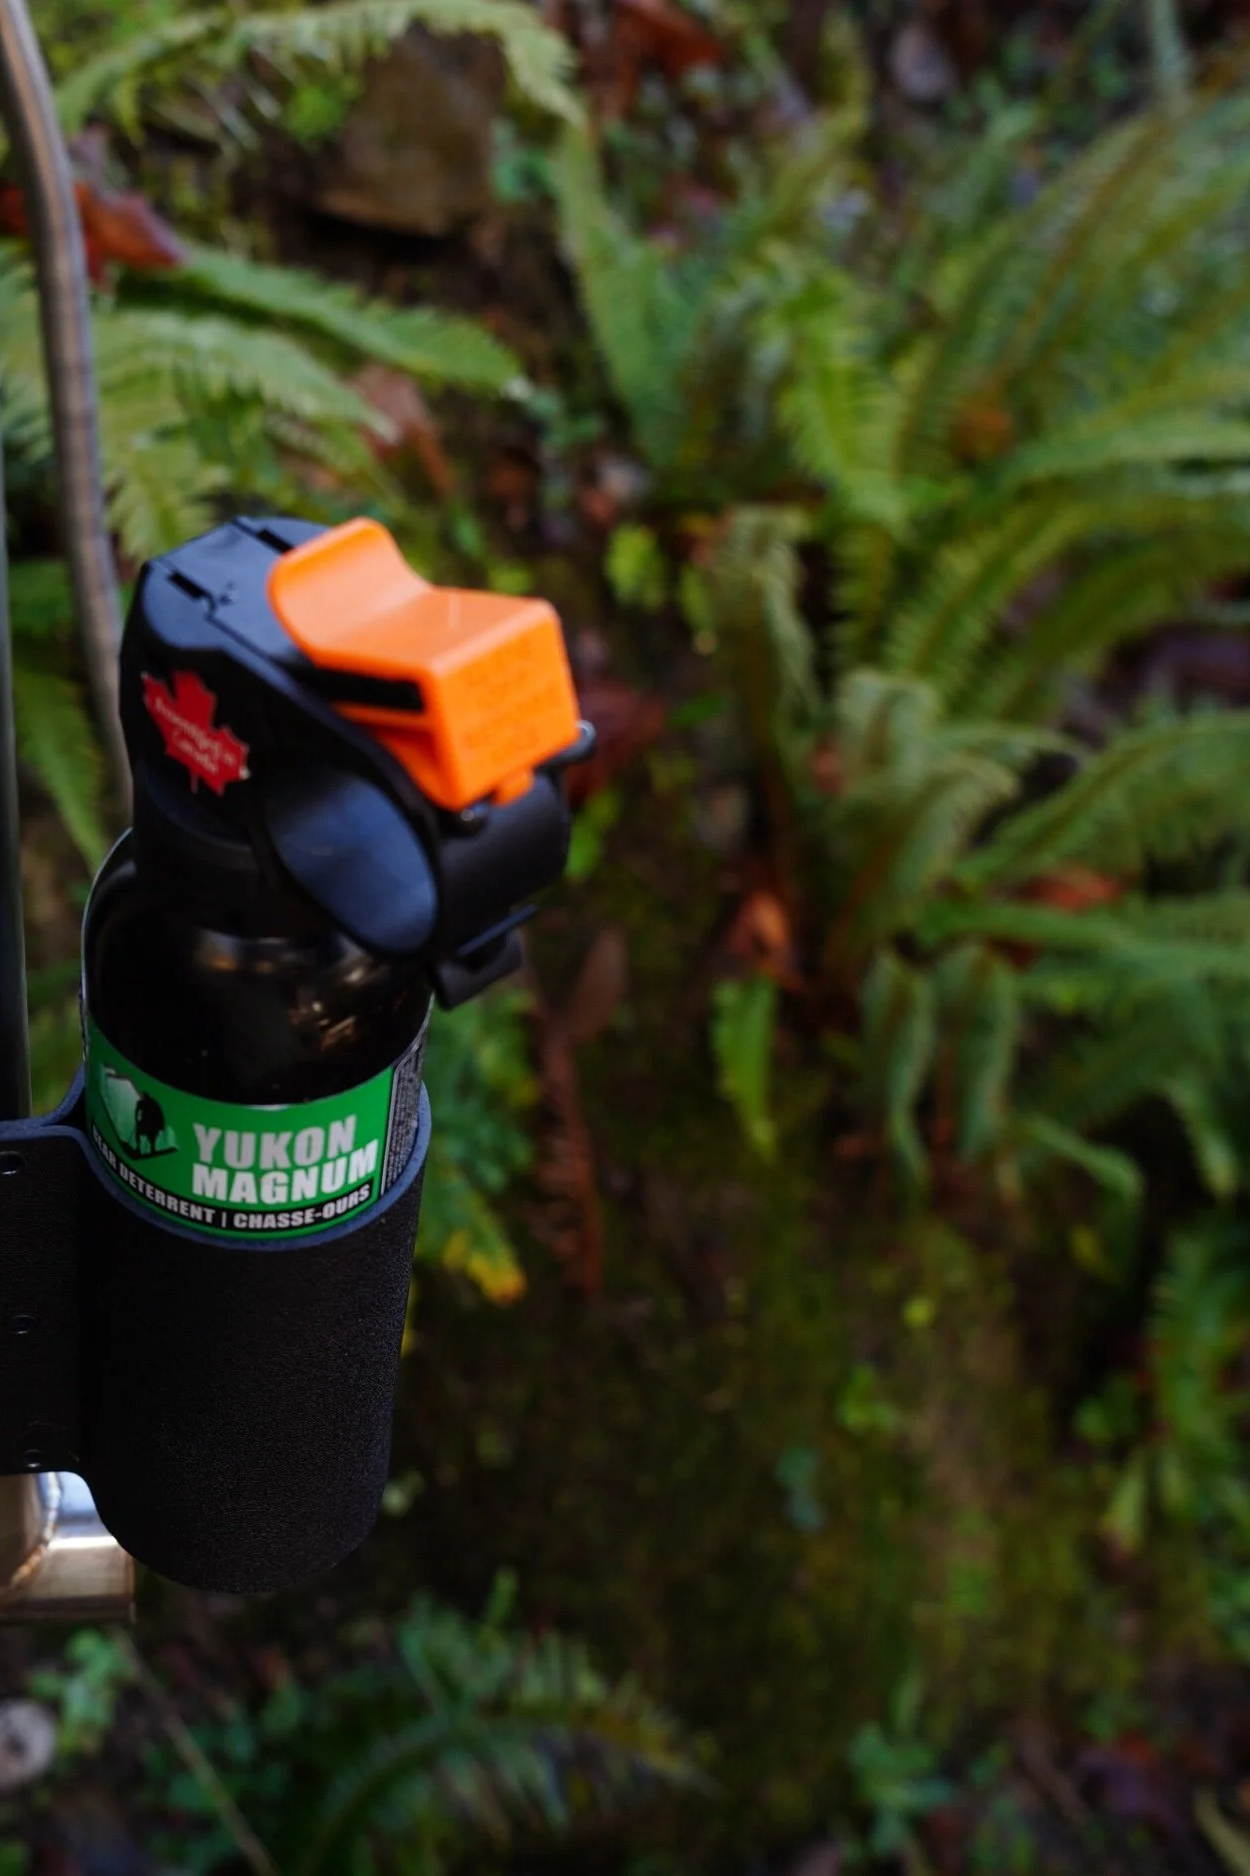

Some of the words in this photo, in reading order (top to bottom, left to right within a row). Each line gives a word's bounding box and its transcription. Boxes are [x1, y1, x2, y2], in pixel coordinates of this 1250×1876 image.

[192, 1115, 358, 1170] YUKON
[192, 1139, 379, 1205] MAGNUM
[119, 1163, 217, 1224] DETERRENT
[233, 1183, 371, 1229] CHASSE-OURS
